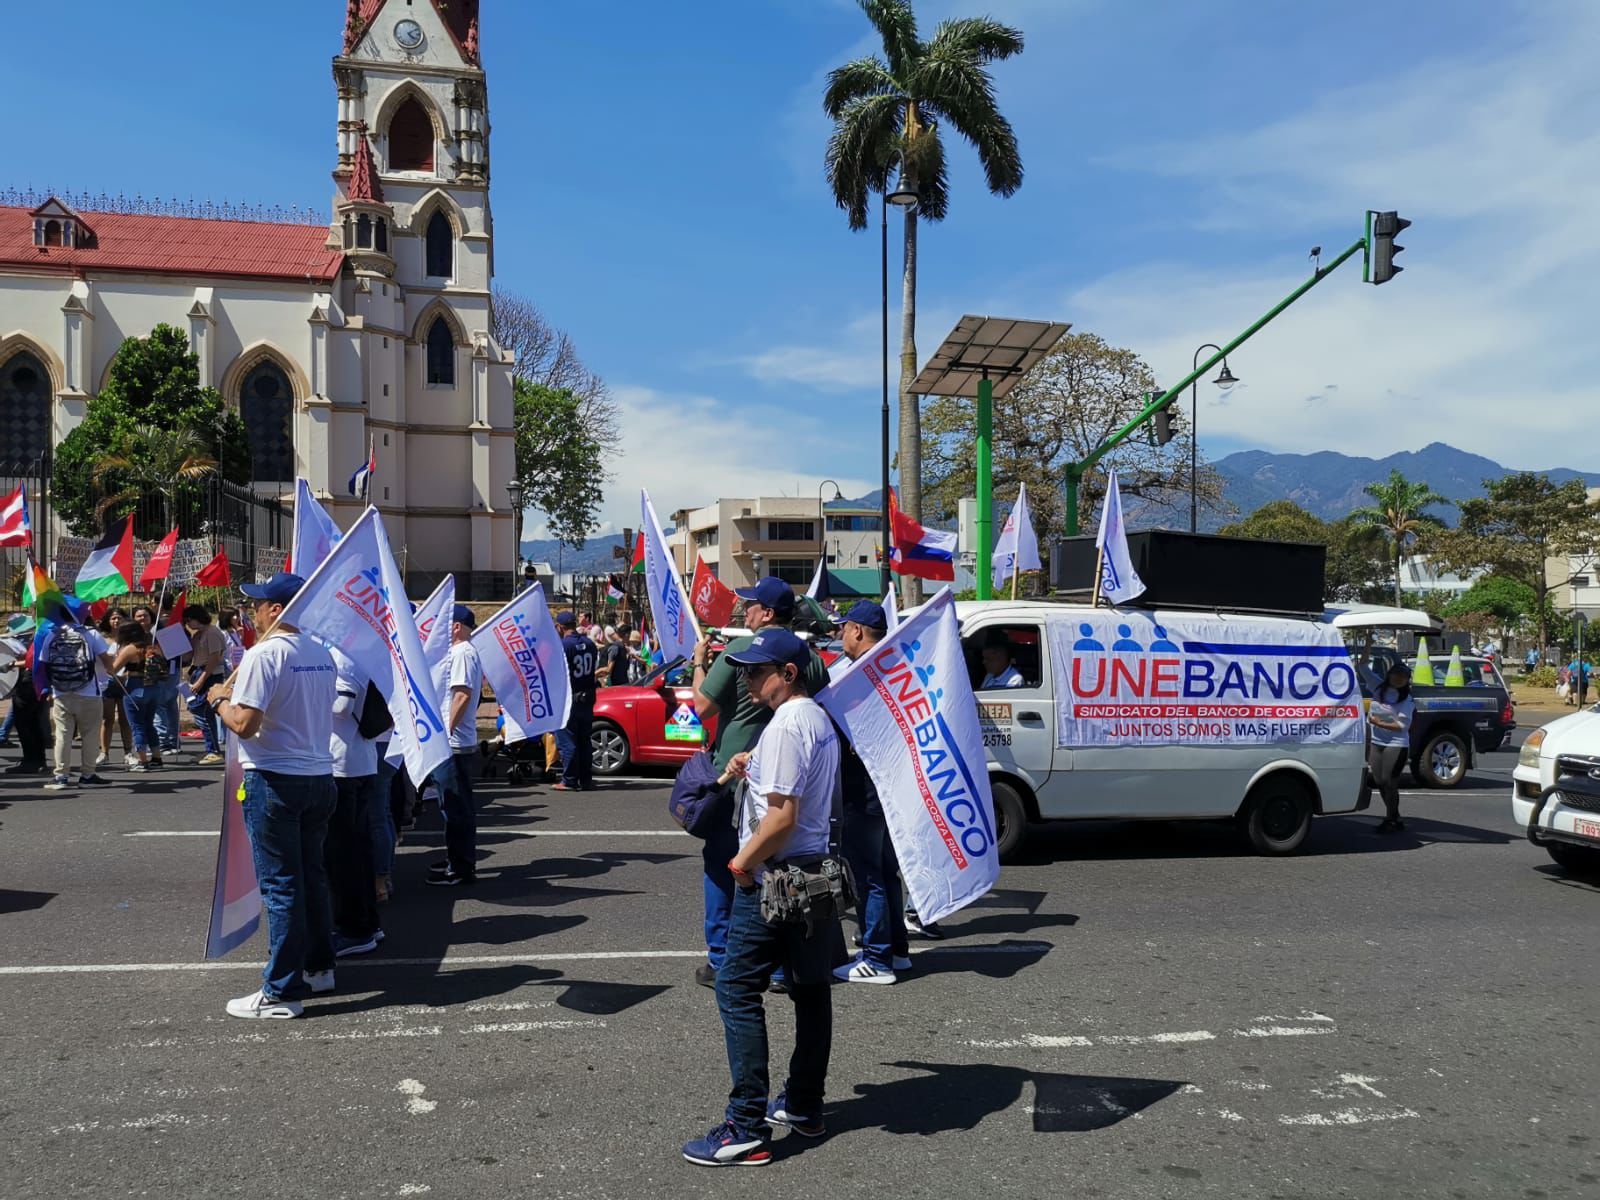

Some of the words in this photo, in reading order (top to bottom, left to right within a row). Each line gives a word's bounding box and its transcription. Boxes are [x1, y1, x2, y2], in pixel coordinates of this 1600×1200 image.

[499, 618, 547, 719] UNEBANCO
[573, 653, 592, 678] 30
[1071, 657, 1355, 700] UNEBANCO
[977, 704, 1011, 719] HEFA
[1080, 706, 1161, 717] SINDICATO
[1165, 706, 1194, 717] DEL
[1197, 706, 1250, 718] BANCO
[1254, 707, 1273, 717] DE
[1275, 707, 1321, 718] COSTA
[1323, 707, 1354, 718] RICA
[1110, 723, 1173, 737] JUNTOS
[1177, 723, 1231, 737] SOMOS
[1235, 723, 1268, 737] MAS
[1271, 722, 1332, 737] FUERTES
[865, 667, 901, 720] SINDICATO
[899, 720, 913, 741] DEL
[909, 741, 923, 779] BANCO
[918, 780, 930, 796] DE
[925, 797, 949, 836] COSTA
[946, 838, 965, 865] RICA
[873, 647, 988, 858] UNEBANCO
